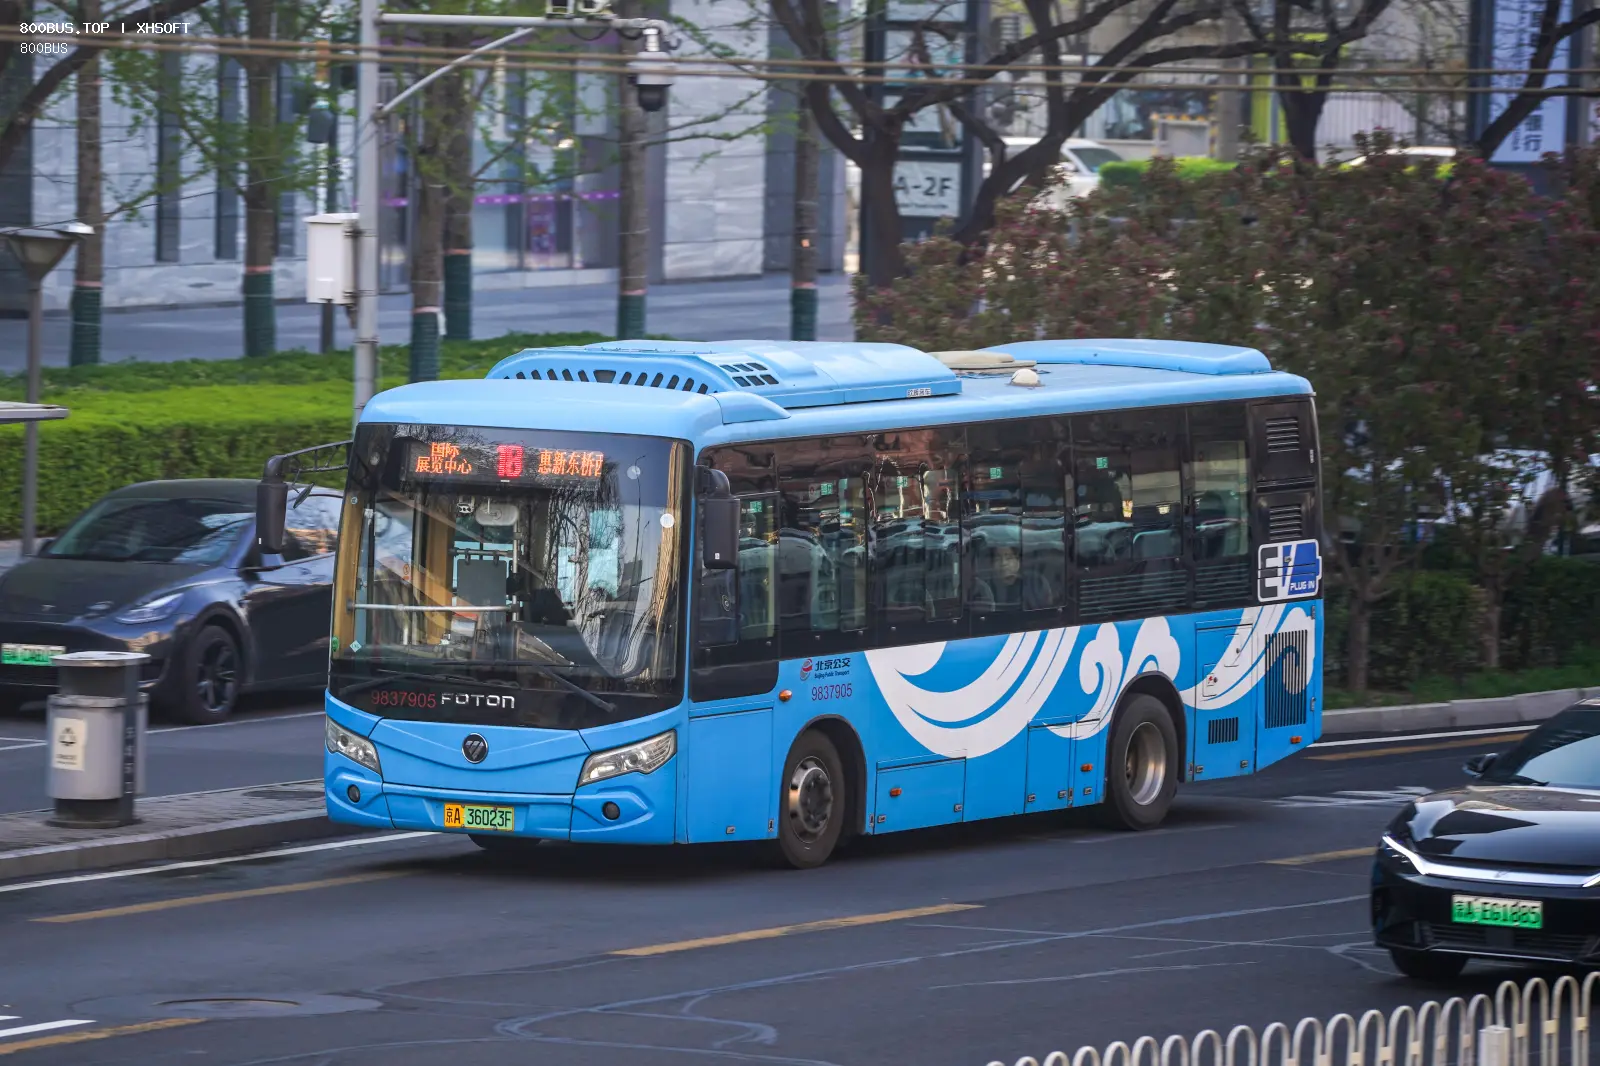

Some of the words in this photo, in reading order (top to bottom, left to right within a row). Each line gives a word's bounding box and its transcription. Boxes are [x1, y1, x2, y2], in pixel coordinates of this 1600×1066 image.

[431, 442, 460, 458] 国际
[415, 456, 473, 474] 展览中心
[814, 657, 852, 672] 北京公交
[371, 690, 437, 708] 9837905
[811, 683, 853, 701] 9837905
